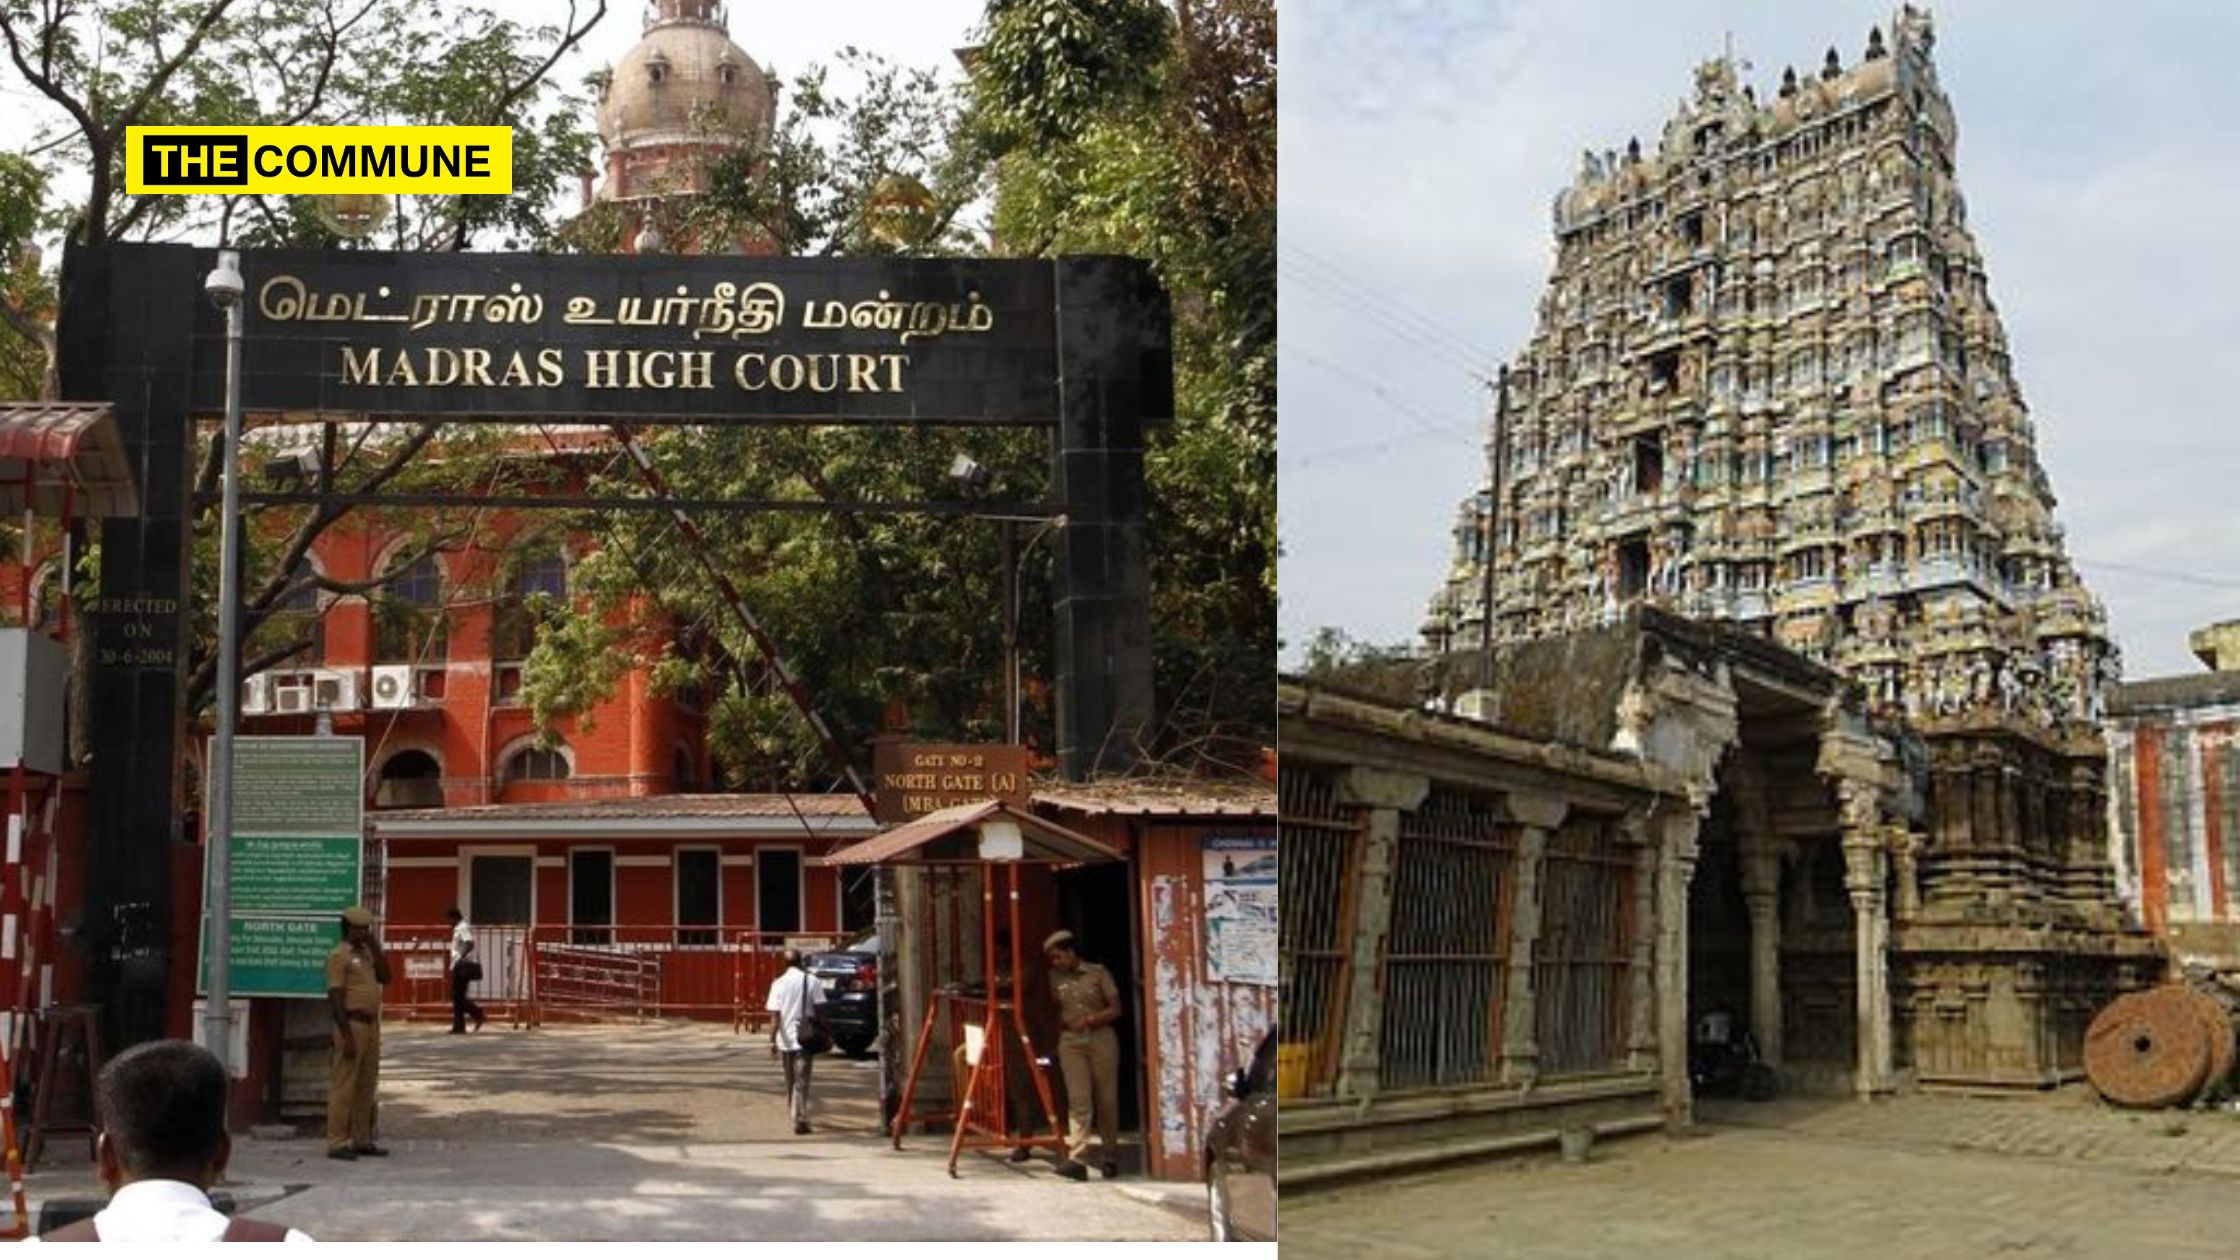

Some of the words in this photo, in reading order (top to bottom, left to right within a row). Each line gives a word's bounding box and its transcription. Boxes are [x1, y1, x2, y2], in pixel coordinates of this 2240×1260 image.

[259, 274, 543, 331] மெட்ராஸ்
[563, 281, 786, 341] உயர்நீதி
[802, 289, 993, 345] மன்றம்
[340, 346, 565, 387] MADRAS
[584, 348, 716, 390] HIGH
[734, 352, 910, 394] COURT
[101, 599, 177, 614] ERECTED
[123, 623, 152, 638] ON
[914, 754, 946, 767] GATE
[884, 774, 937, 791] NORTH
[942, 775, 983, 791] GATE
[243, 922, 285, 933] NORTH
[287, 922, 318, 933] GATE
